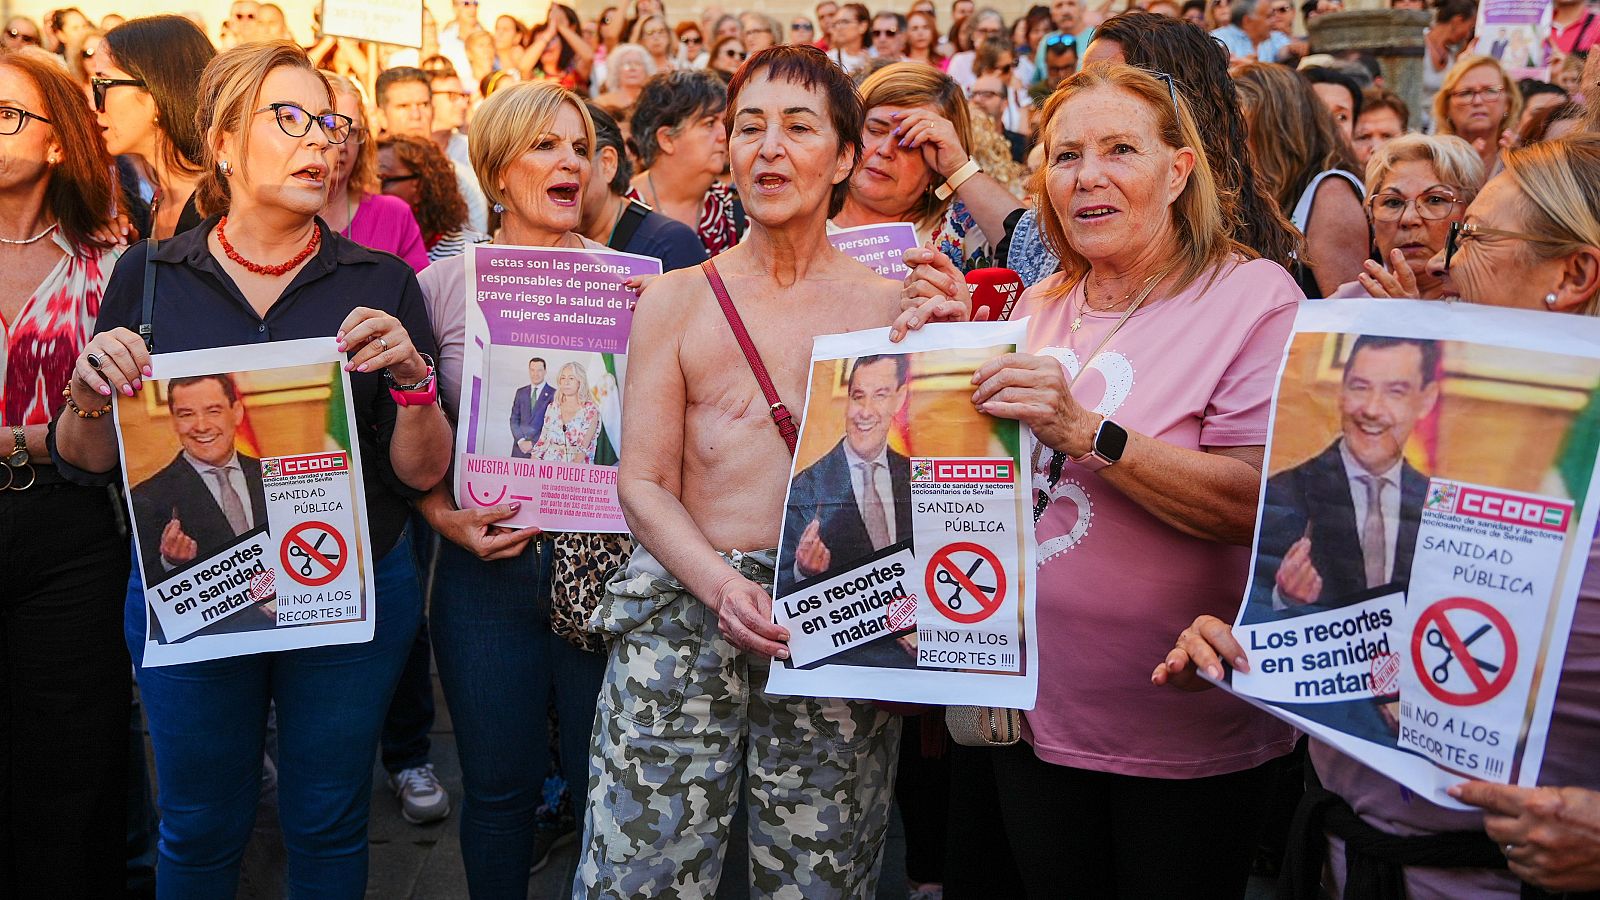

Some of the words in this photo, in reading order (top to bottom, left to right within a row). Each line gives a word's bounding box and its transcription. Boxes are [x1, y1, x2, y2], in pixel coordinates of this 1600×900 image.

[839, 235, 890, 252] personas
[888, 248, 901, 257] en
[491, 258, 523, 268] estas
[527, 260, 549, 269] son
[553, 259, 570, 270] las
[574, 262, 630, 274] personas
[876, 265, 889, 275] de
[892, 263, 908, 273] las
[481, 273, 562, 288] responsables
[566, 278, 581, 289] de
[585, 280, 621, 291] poner
[478, 290, 512, 301] grave
[516, 291, 552, 305] riesgo
[556, 293, 567, 304] la
[570, 295, 603, 307] salud
[608, 297, 622, 309] de
[501, 308, 550, 322] mujeres
[554, 313, 616, 326] andaluzas
[512, 332, 583, 347] DIMISIONES
[588, 338, 617, 350] YA!!!!
[468, 459, 509, 475] NUESTRA
[514, 463, 535, 478] VIDA
[539, 466, 552, 479] NO
[557, 467, 585, 482] PUEDE
[270, 488, 325, 501] SANIDAD
[294, 502, 343, 514] PÚBLICA
[918, 502, 985, 513] SANIDAD
[945, 517, 1005, 532] PÚBLICA
[1422, 519, 1486, 536] sociosanitarios
[1503, 533, 1532, 544] Sevilla
[1424, 511, 1461, 522] sindicato
[1478, 520, 1513, 532] sanidad
[1524, 529, 1563, 541] sectores
[1423, 536, 1513, 564] SANIDAD
[157, 580, 192, 602] Los
[194, 544, 263, 585] recortes
[1453, 564, 1534, 595] PÚBLICA
[175, 596, 197, 614] en
[199, 559, 266, 602] sanidad
[784, 595, 821, 619] Los
[824, 562, 905, 603] recortes
[201, 588, 255, 621] matan
[294, 594, 312, 605] NO
[316, 593, 323, 602] A
[328, 591, 351, 601] LOS
[802, 616, 827, 634] en
[829, 581, 907, 624] sanidad
[279, 608, 342, 622] RECORTES
[346, 606, 356, 616] !!!!
[831, 614, 892, 647] matan
[937, 631, 960, 642] NO
[965, 632, 974, 643] A
[978, 633, 1007, 645] LOS
[1251, 630, 1298, 650] Los
[1304, 608, 1392, 643] recortes
[920, 650, 996, 665] RECORTES
[1001, 654, 1014, 667] !!!!
[1261, 656, 1293, 673] en
[1302, 632, 1390, 671] sanidad
[1295, 672, 1376, 696] matan
[1416, 706, 1438, 727] NO
[1443, 717, 1454, 734] A
[1461, 722, 1500, 746] LOS
[1402, 726, 1479, 769] RECORTES
